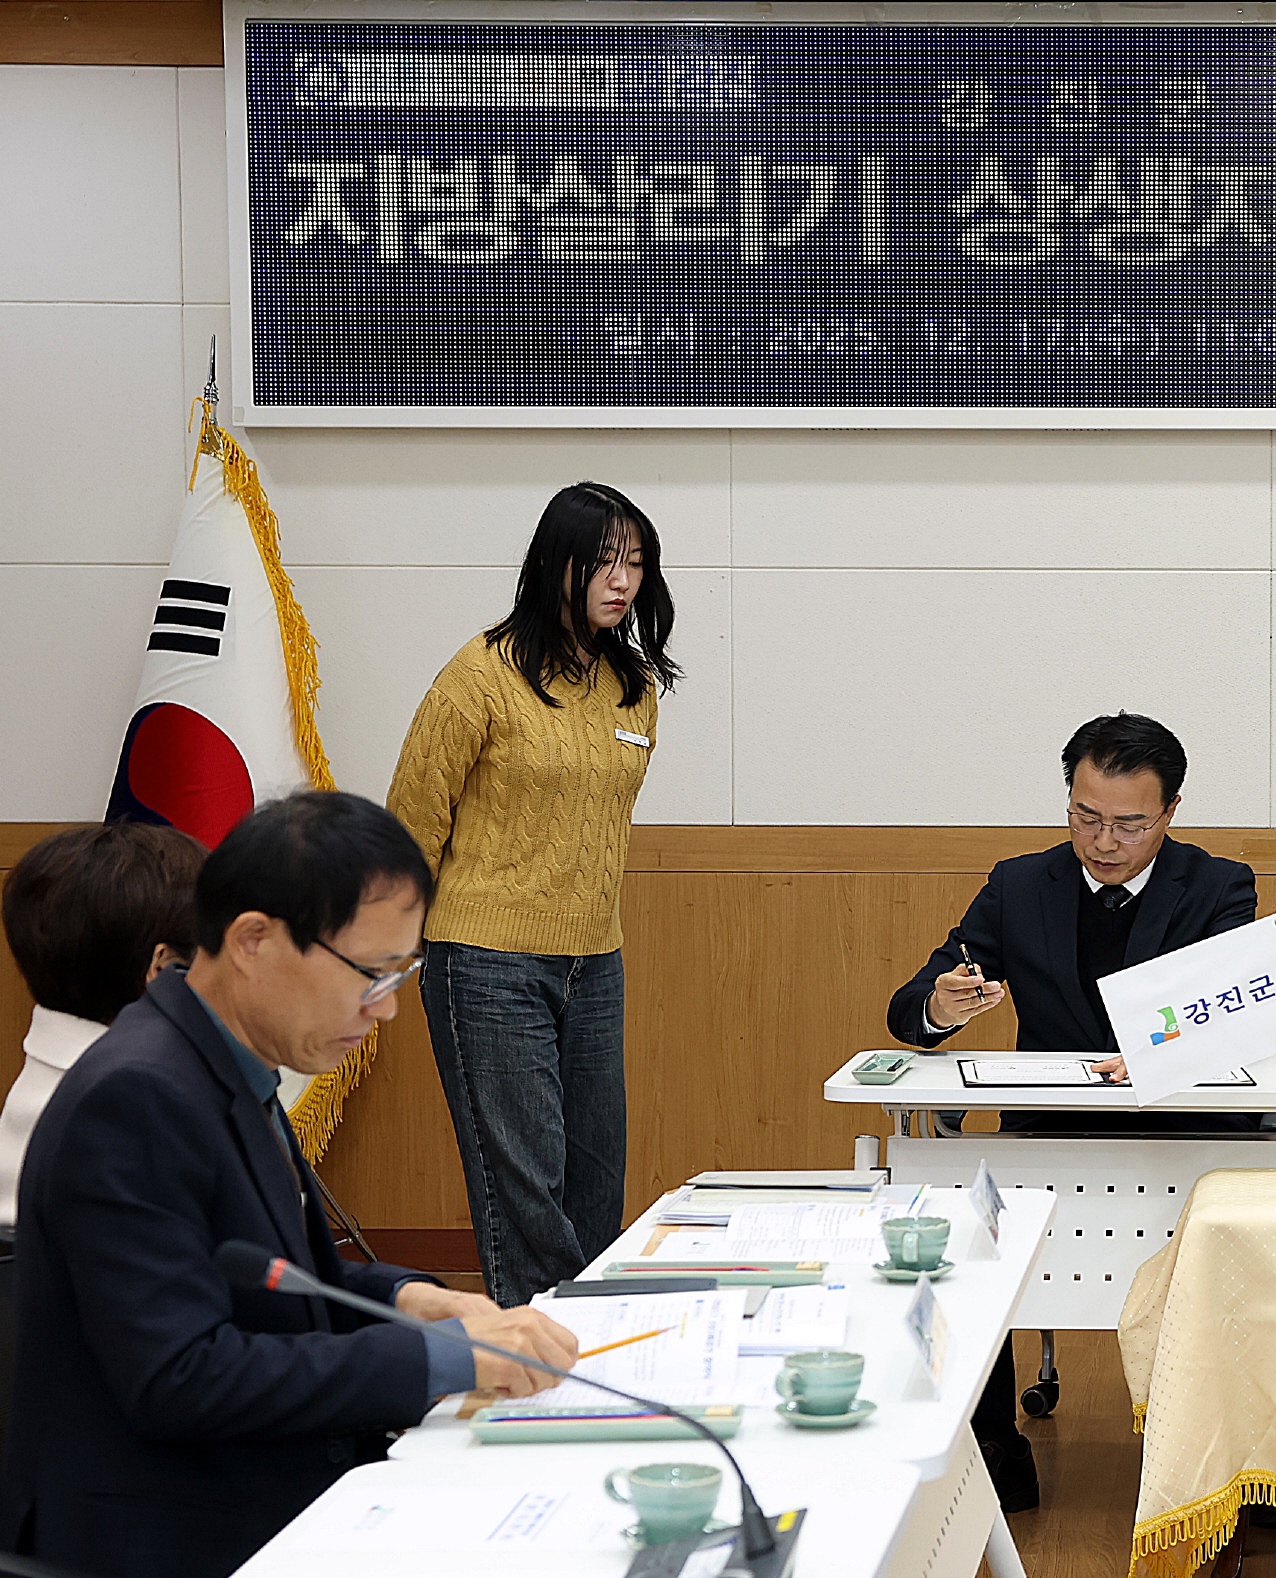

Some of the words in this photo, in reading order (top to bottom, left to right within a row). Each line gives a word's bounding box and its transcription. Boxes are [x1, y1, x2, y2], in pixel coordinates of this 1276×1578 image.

[284, 154, 888, 263] 지방살리기
[604, 311, 696, 356] 일시
[766, 317, 890, 356] 2025.
[922, 317, 982, 356] 12.
[1183, 974, 1276, 1026] 강진군
